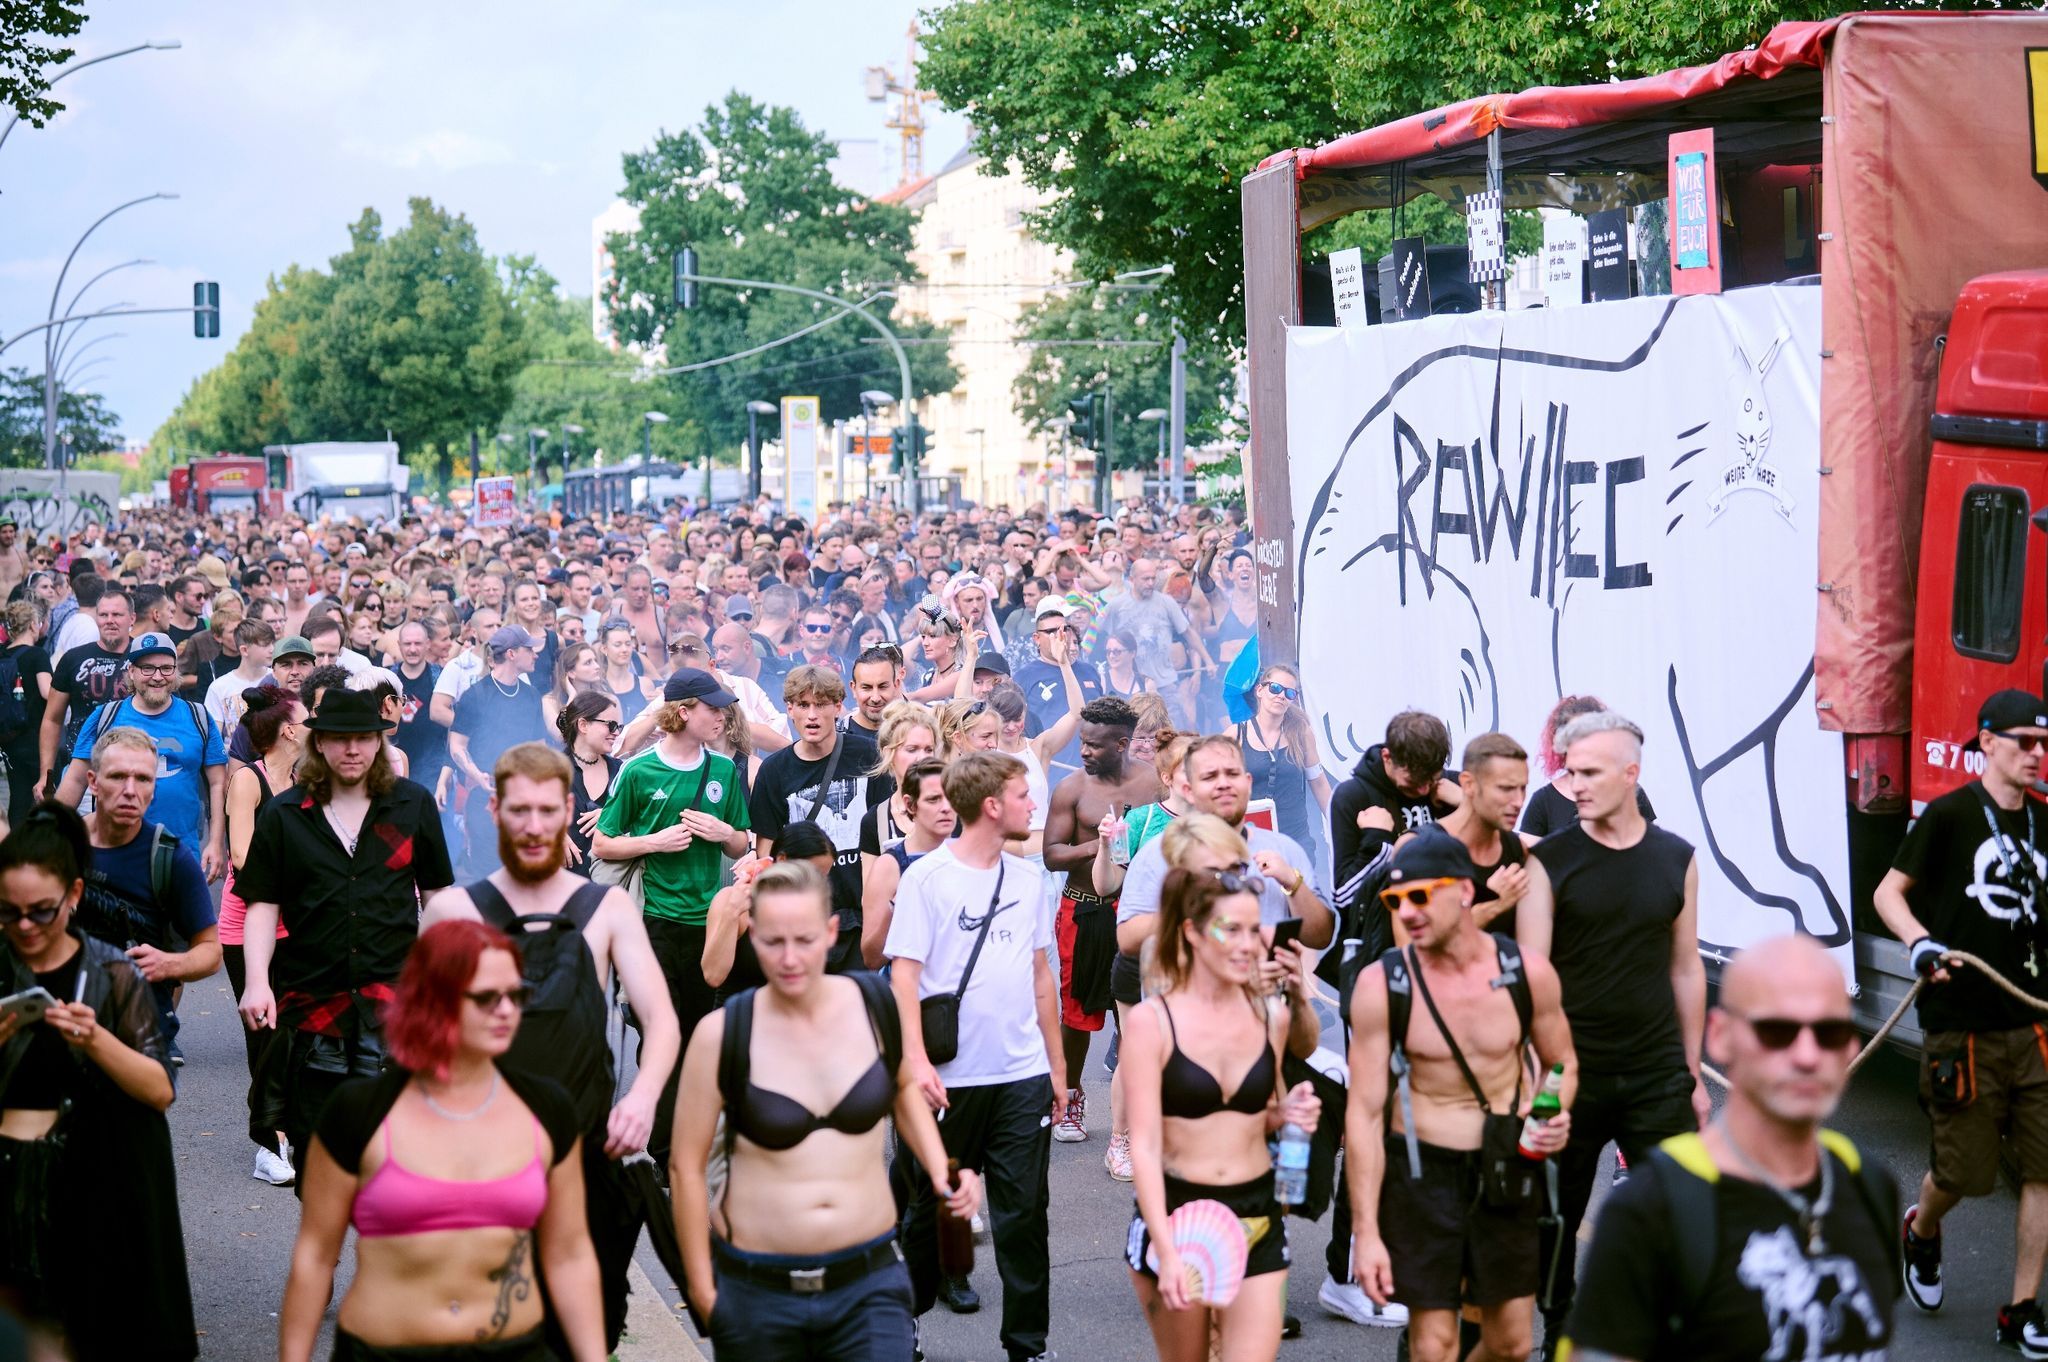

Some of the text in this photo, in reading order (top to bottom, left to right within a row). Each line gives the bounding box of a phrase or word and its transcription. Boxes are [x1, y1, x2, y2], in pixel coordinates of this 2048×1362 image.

[1678, 164, 1703, 194] WIR
[1681, 192, 1706, 222] FÜR
[1680, 223, 1707, 253] EUCH
[1757, 467, 1776, 488] HASE
[1950, 745, 1961, 769] 7
[991, 930, 1013, 944] IR
